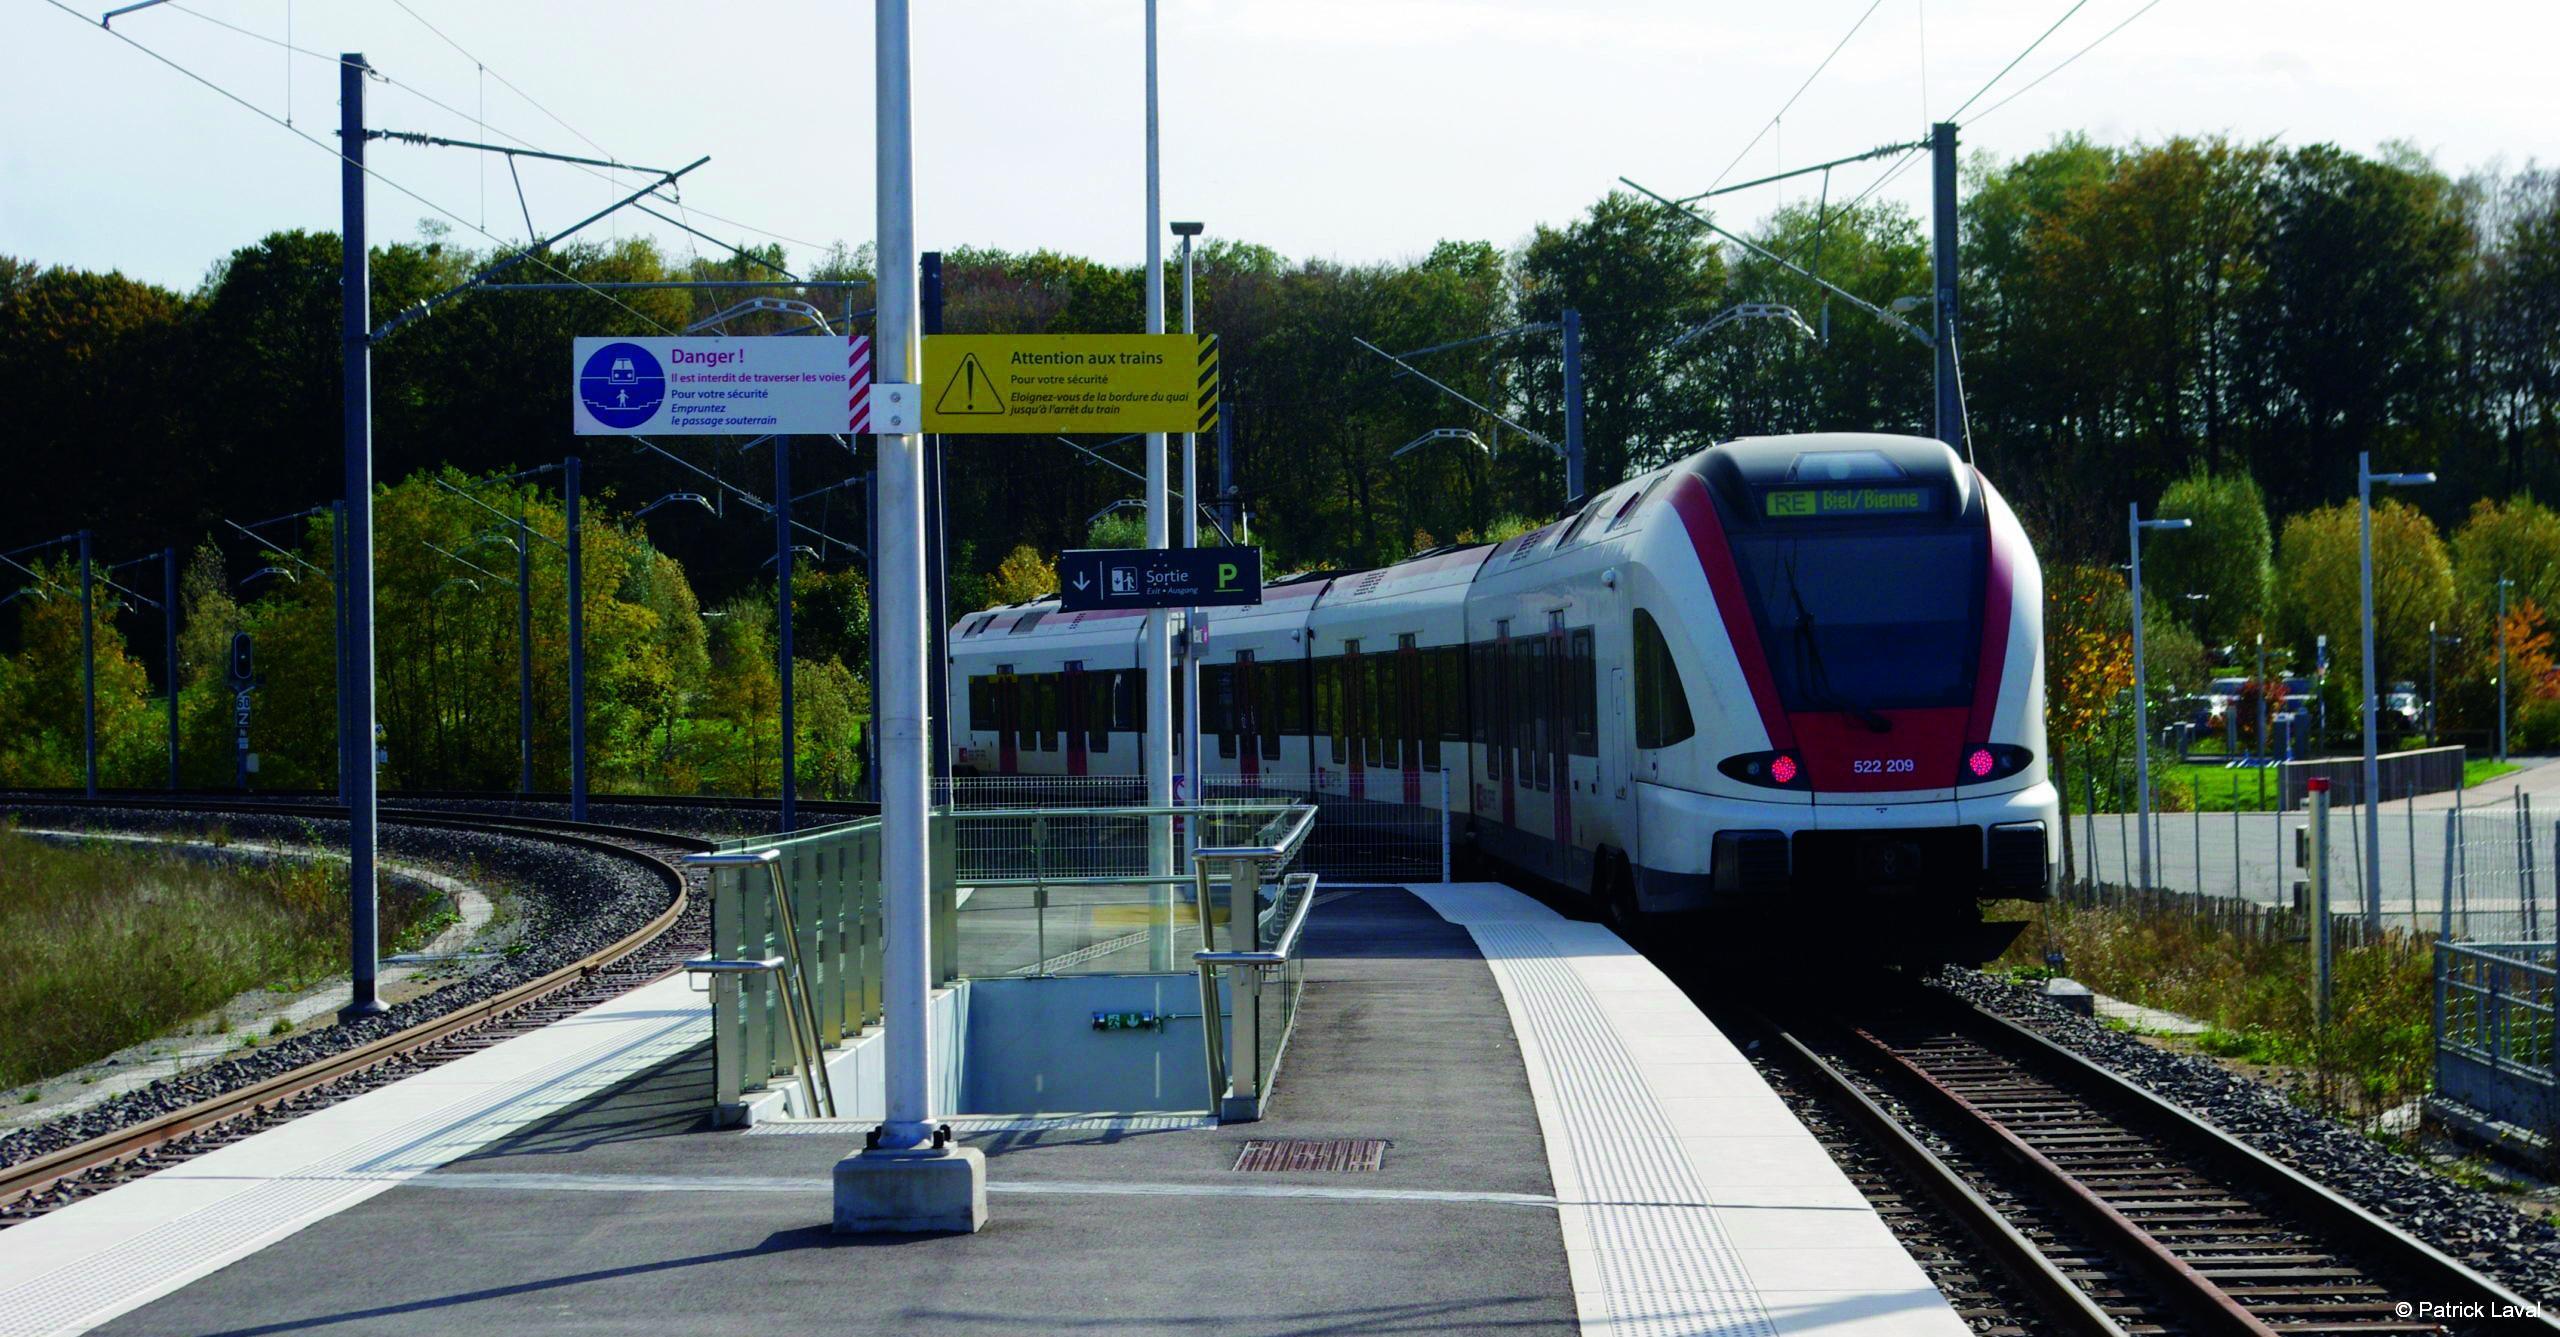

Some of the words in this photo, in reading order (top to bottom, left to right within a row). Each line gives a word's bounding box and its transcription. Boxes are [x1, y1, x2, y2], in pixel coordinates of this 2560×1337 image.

[672, 349, 735, 367] Danger
[1011, 351, 1084, 365] Attention
[1088, 354, 1115, 364] aux
[1119, 351, 1163, 364] trains
[672, 373, 677, 383] Il
[680, 374, 696, 383] est
[698, 373, 736, 383] interdit
[738, 373, 752, 382] de
[754, 374, 800, 382] traverser
[802, 372, 816, 382] les
[819, 373, 846, 382] voies
[1011, 375, 1034, 384] Pour
[1067, 374, 1108, 384] sécurité
[672, 390, 696, 398] Pour
[727, 390, 768, 398] sécurité
[1010, 392, 1080, 404] Eloignez-vous
[1084, 392, 1096, 401] de
[1099, 392, 1107, 401] la
[1109, 392, 1149, 401] bordure
[1151, 392, 1164, 401] du
[1166, 392, 1188, 404] quai
[671, 404, 726, 414] Empruntez
[1081, 405, 1094, 414] du
[1096, 405, 1120, 414] train
[672, 416, 680, 424] le
[682, 418, 723, 427] passage
[725, 416, 776, 424] souterrain
[1775, 493, 1806, 512] RE
[1824, 490, 1918, 509] Biel/Bienne
[1146, 570, 1189, 583] Sortie
[1218, 563, 1237, 588] P
[1854, 760, 1882, 773] 522
[1886, 759, 1913, 772] 209
